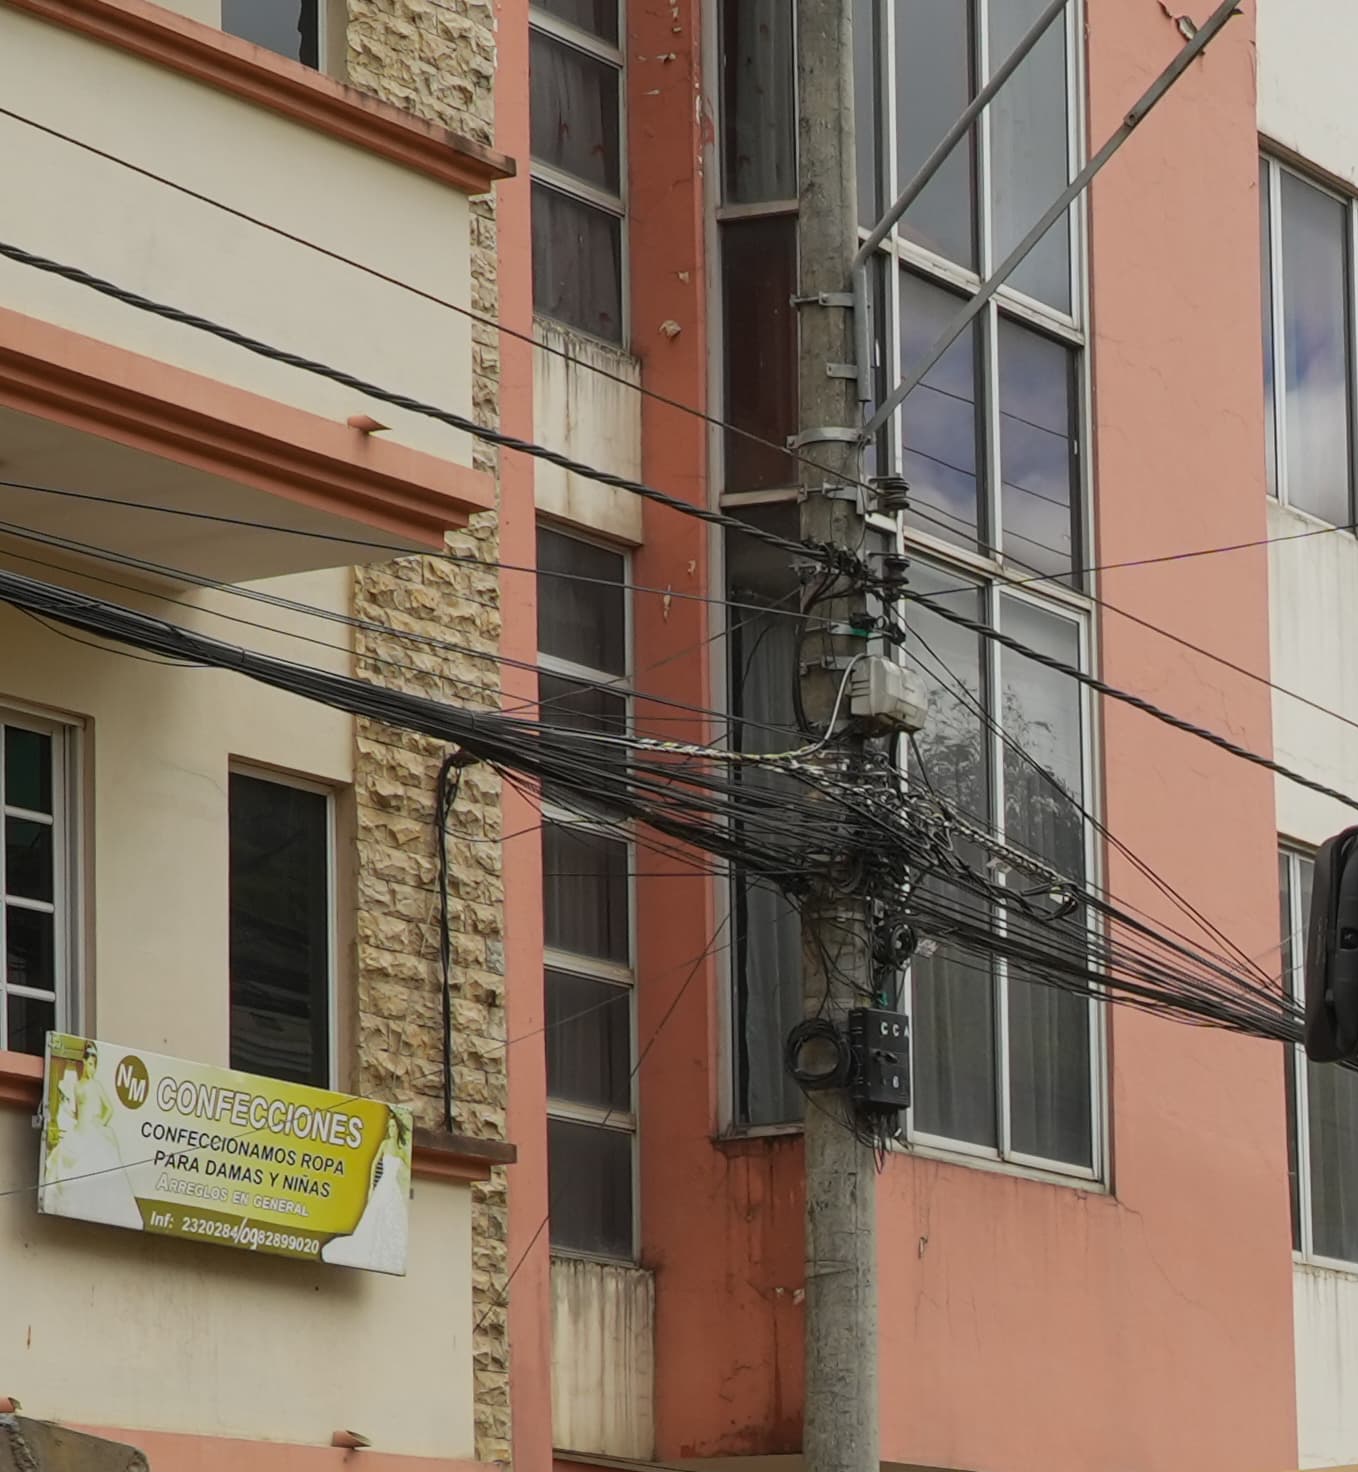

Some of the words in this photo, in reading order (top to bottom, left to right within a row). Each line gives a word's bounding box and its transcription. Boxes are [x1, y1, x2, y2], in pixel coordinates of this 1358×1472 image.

[156, 1076, 364, 1149] CONFECCIONES
[141, 1121, 296, 1166] CONFECCIONAMOS
[301, 1153, 345, 1176] ROPA
[153, 1150, 200, 1173] PARA
[205, 1160, 263, 1185] DAMAS
[269, 1172, 278, 1187] Y
[283, 1174, 331, 1198] NIÑAS
[150, 1211, 174, 1229] Inf:
